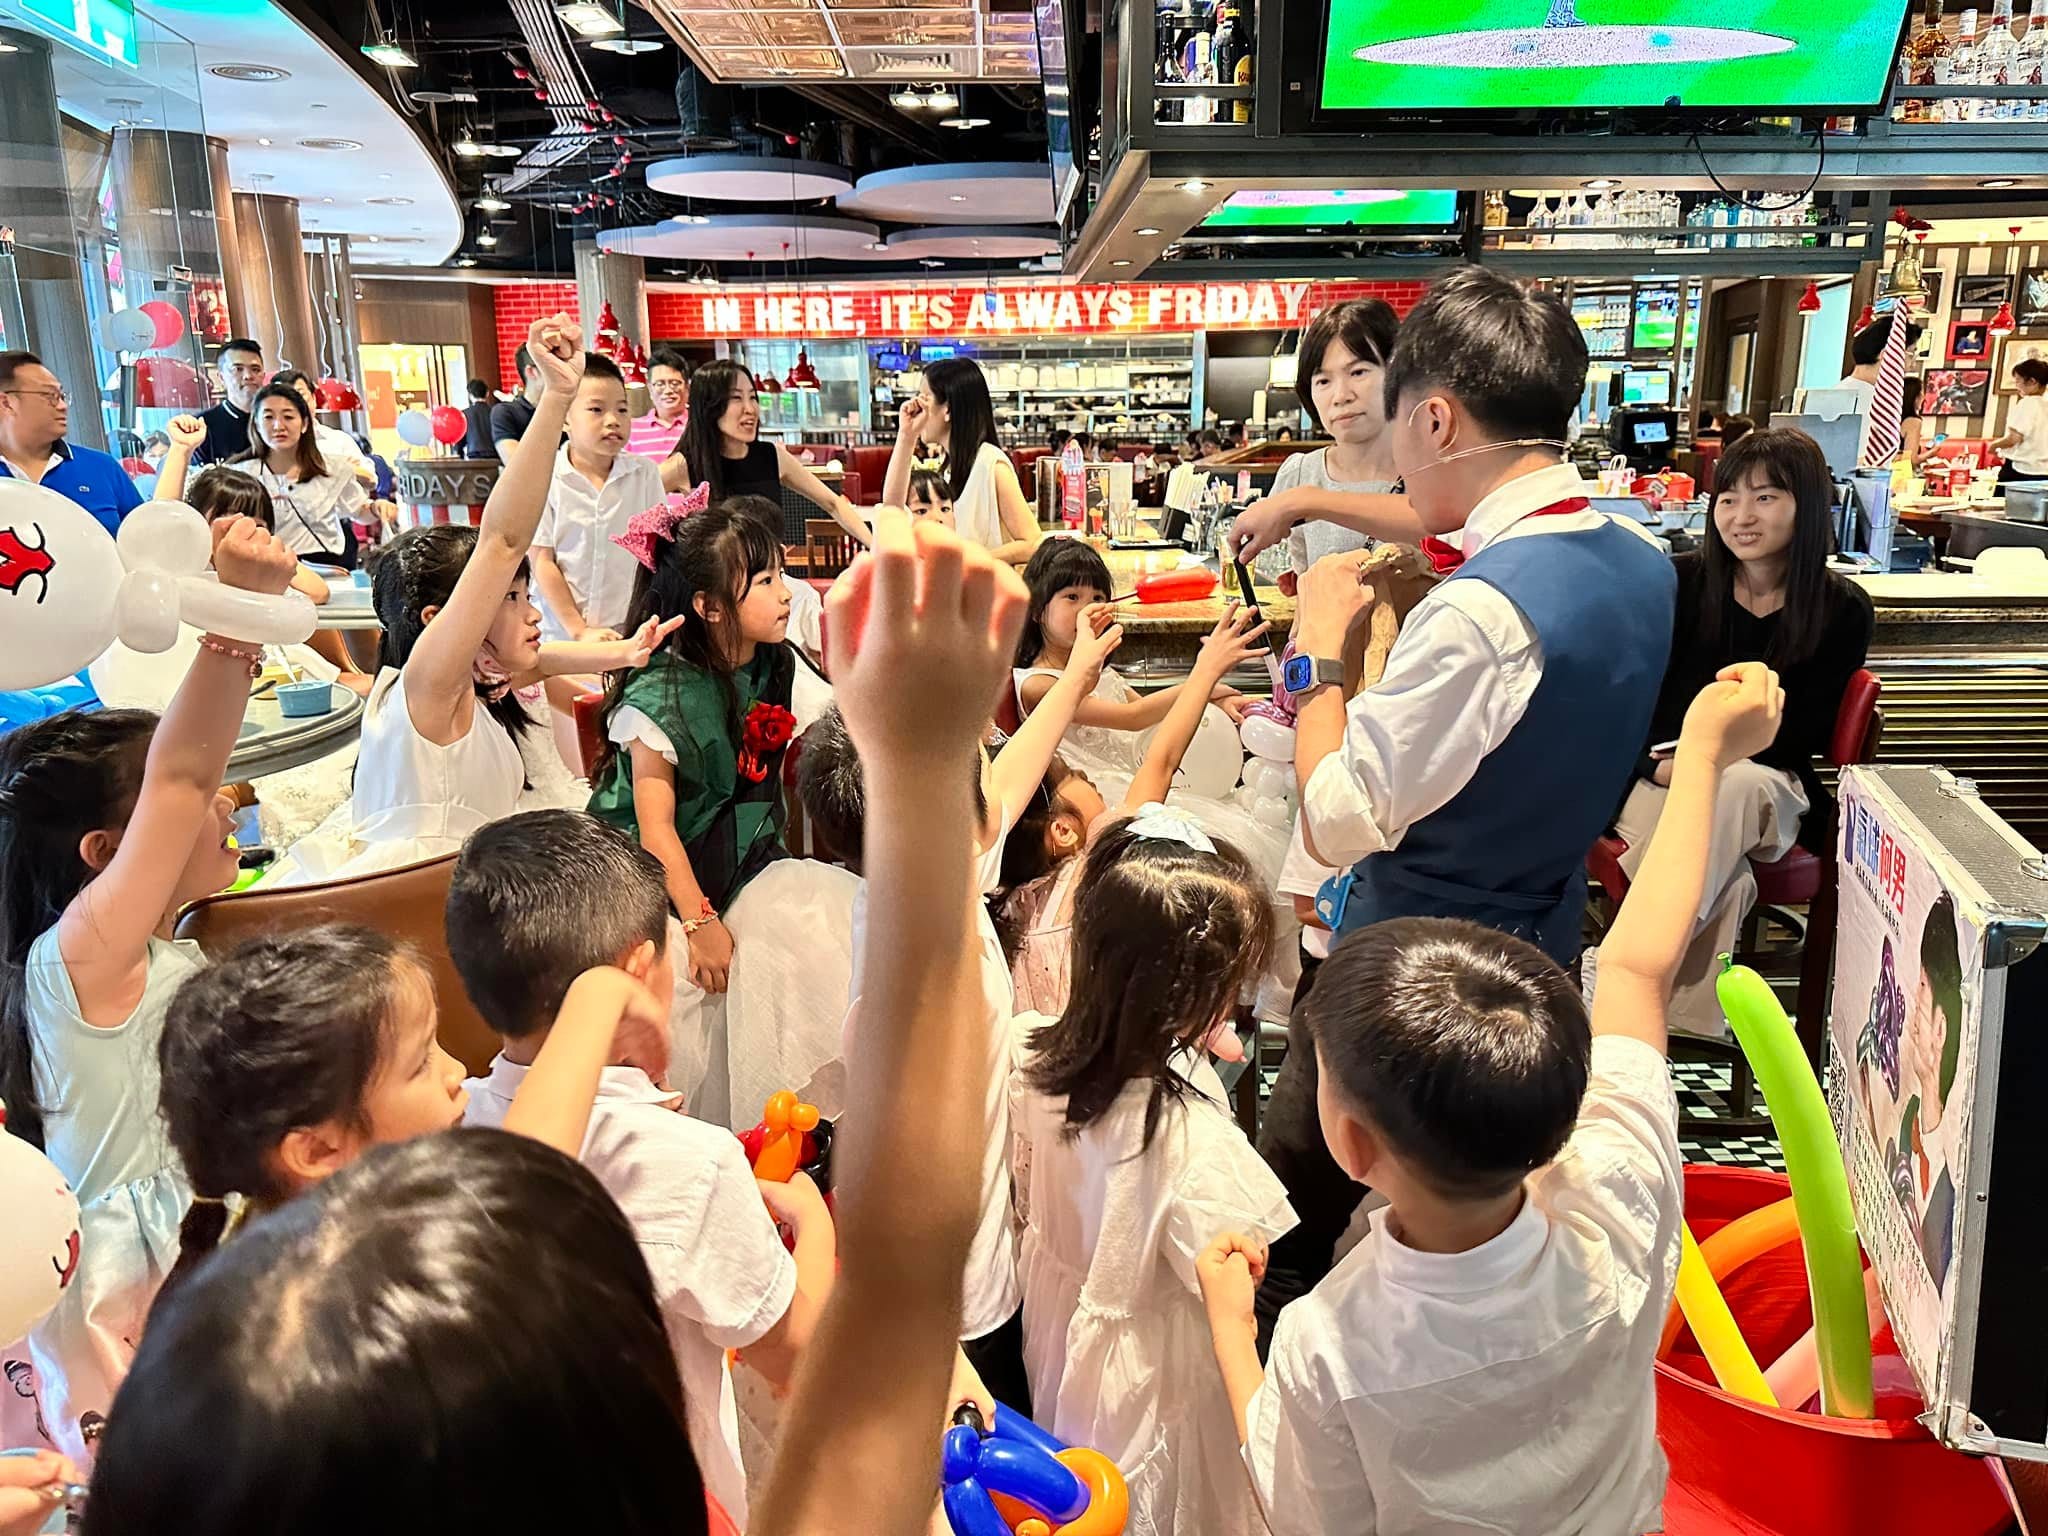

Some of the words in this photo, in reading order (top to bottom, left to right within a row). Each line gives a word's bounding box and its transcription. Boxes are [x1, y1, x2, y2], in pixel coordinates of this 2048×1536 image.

[703, 298, 741, 331] IN
[755, 295, 866, 336] HERE,
[881, 295, 954, 330] IT'S
[966, 289, 1134, 328] ALWAYS
